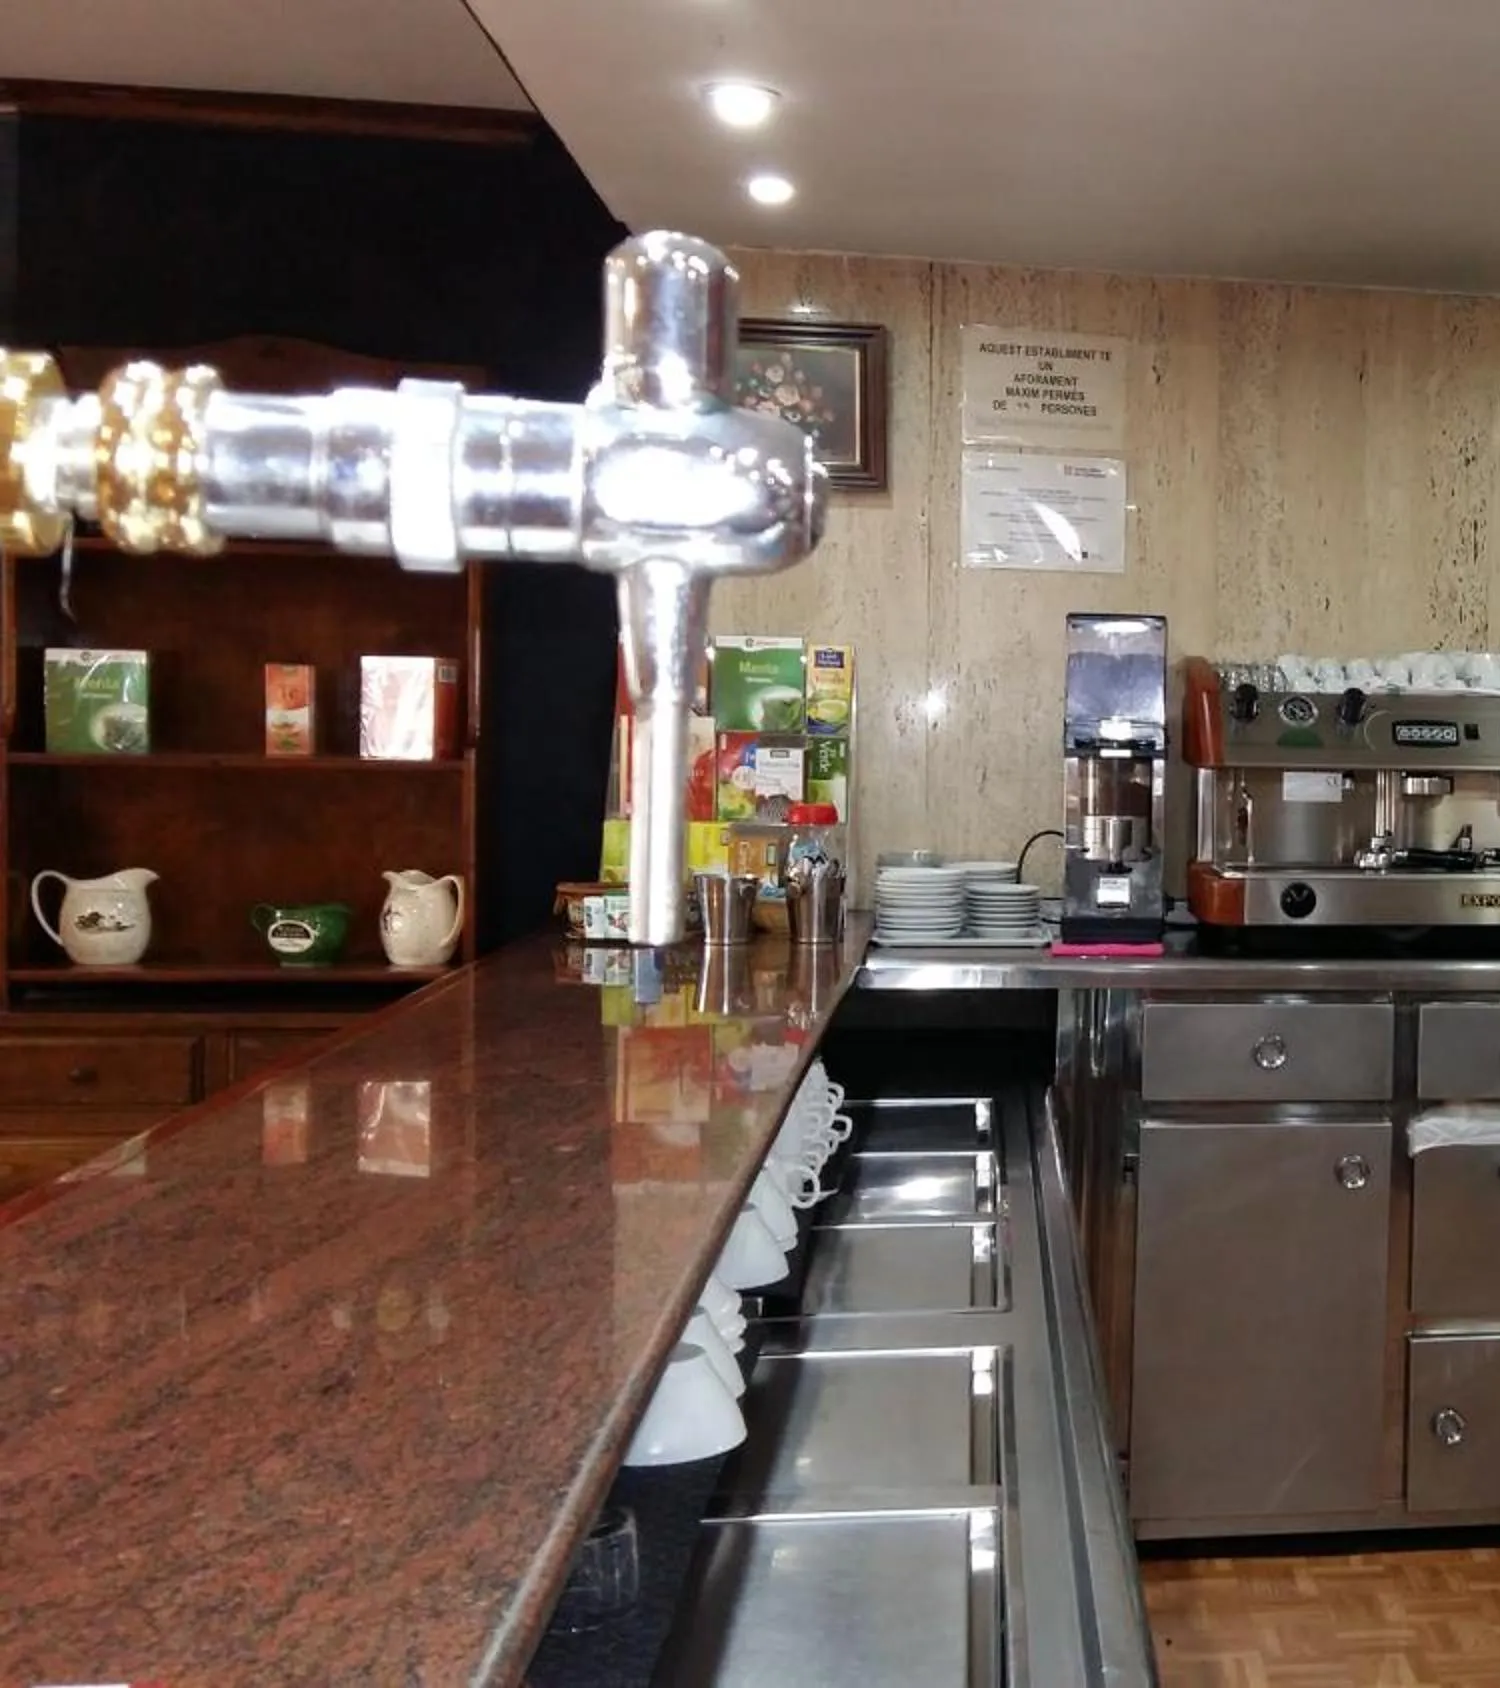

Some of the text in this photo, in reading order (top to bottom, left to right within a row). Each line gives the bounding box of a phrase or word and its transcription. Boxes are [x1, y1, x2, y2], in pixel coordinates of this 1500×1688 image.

[1038, 362, 1053, 372] UN
[1013, 373, 1079, 387] AFORAMENT
[992, 400, 1007, 411] DE
[1041, 402, 1097, 417] PERSONES
